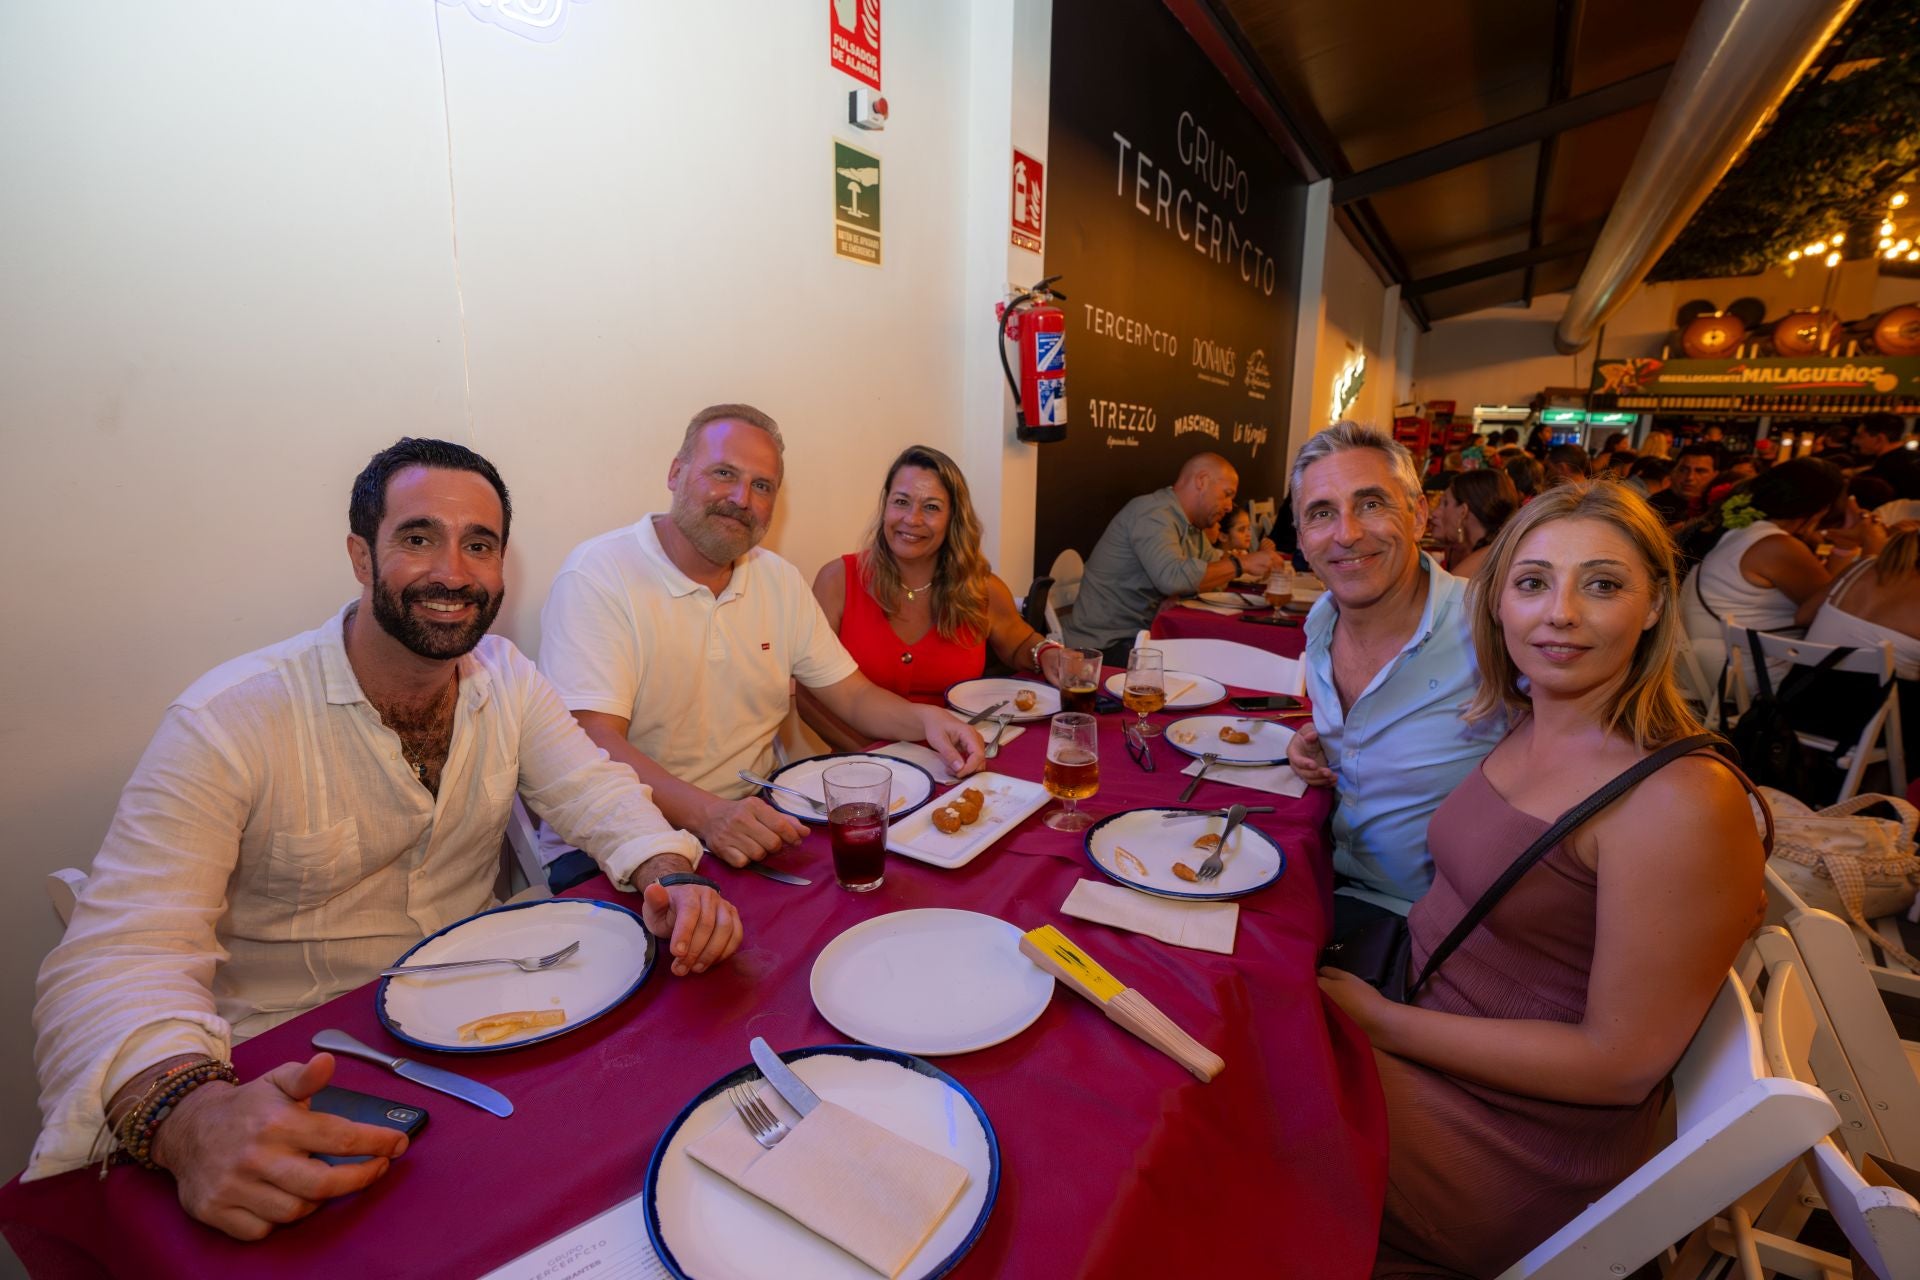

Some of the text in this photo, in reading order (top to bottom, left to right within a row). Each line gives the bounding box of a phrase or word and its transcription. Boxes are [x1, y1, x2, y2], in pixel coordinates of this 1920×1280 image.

[832, 46, 880, 82] DE ALARMA
[833, 33, 878, 68] PULSADOR
[1177, 111, 1249, 215] GRUPO
[1741, 364, 1885, 383] MALAGUEÑOS
[1089, 398, 1157, 433] ATREZZO
[1174, 414, 1220, 440] MASCHERA
[547, 1244, 583, 1267] GRUPO
